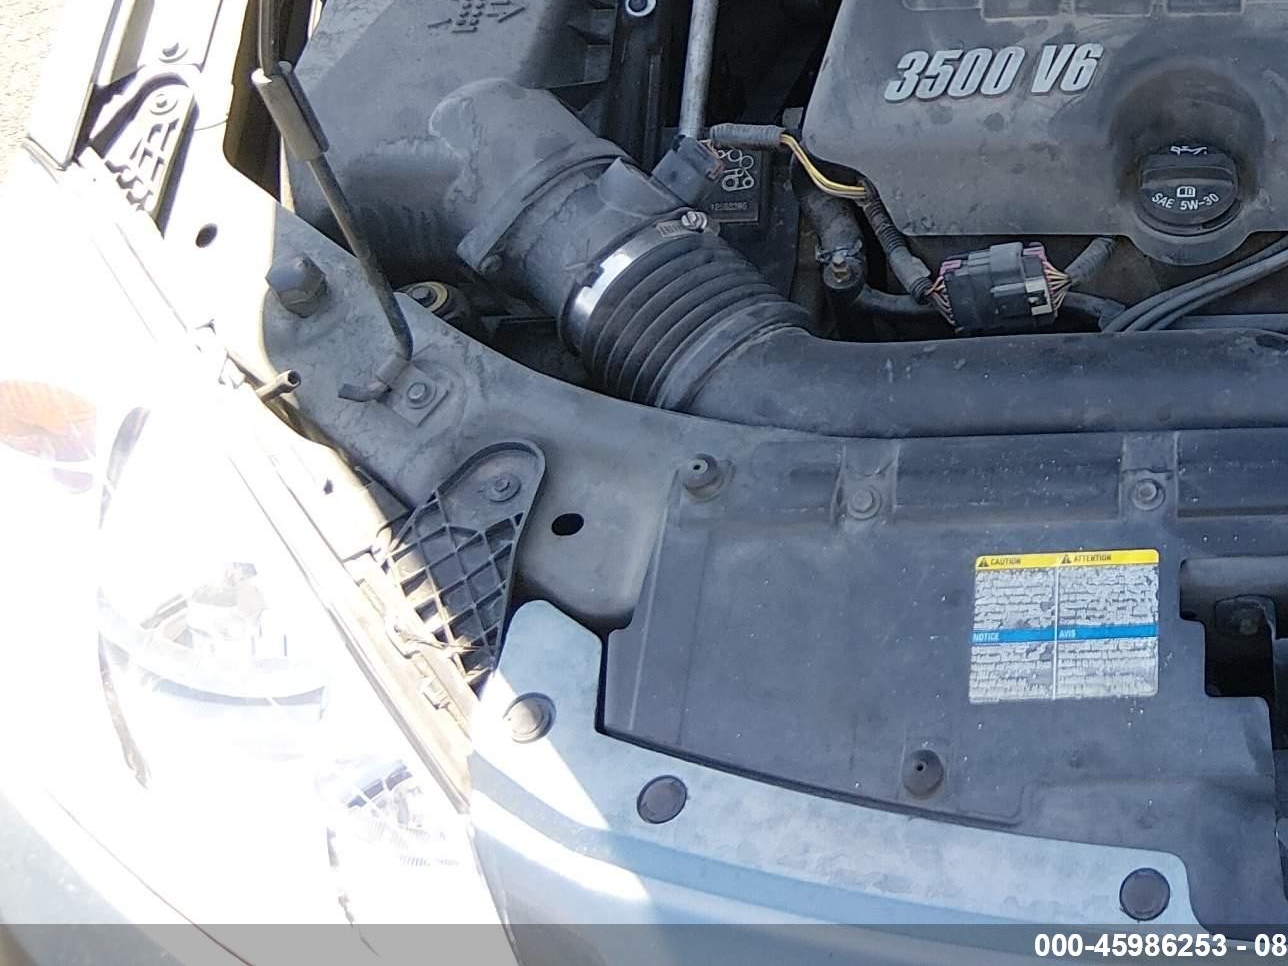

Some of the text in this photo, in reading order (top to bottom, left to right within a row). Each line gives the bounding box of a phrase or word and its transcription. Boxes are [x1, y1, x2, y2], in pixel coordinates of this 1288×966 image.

[883, 42, 1104, 104] 3500 V6
[1151, 192, 1220, 211] SAE 5W-30
[990, 553, 1112, 566] CAUTION ATTENTION
[973, 629, 1076, 642] NOTICE AVIS
